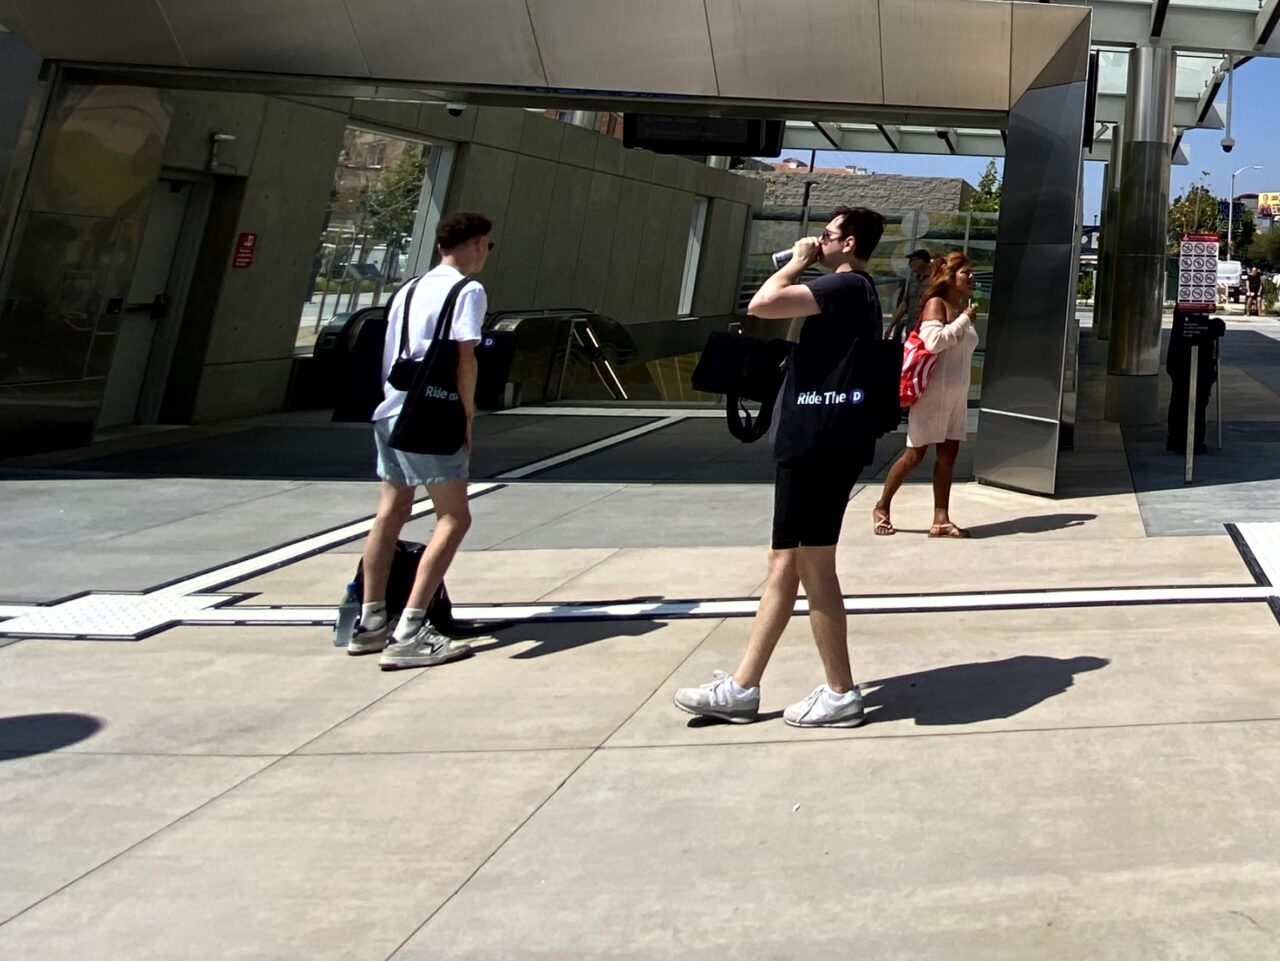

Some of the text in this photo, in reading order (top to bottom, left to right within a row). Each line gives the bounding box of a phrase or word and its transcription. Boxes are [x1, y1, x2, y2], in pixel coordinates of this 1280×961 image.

[425, 385, 448, 399] Ride
[796, 390, 861, 405] Ride The D
